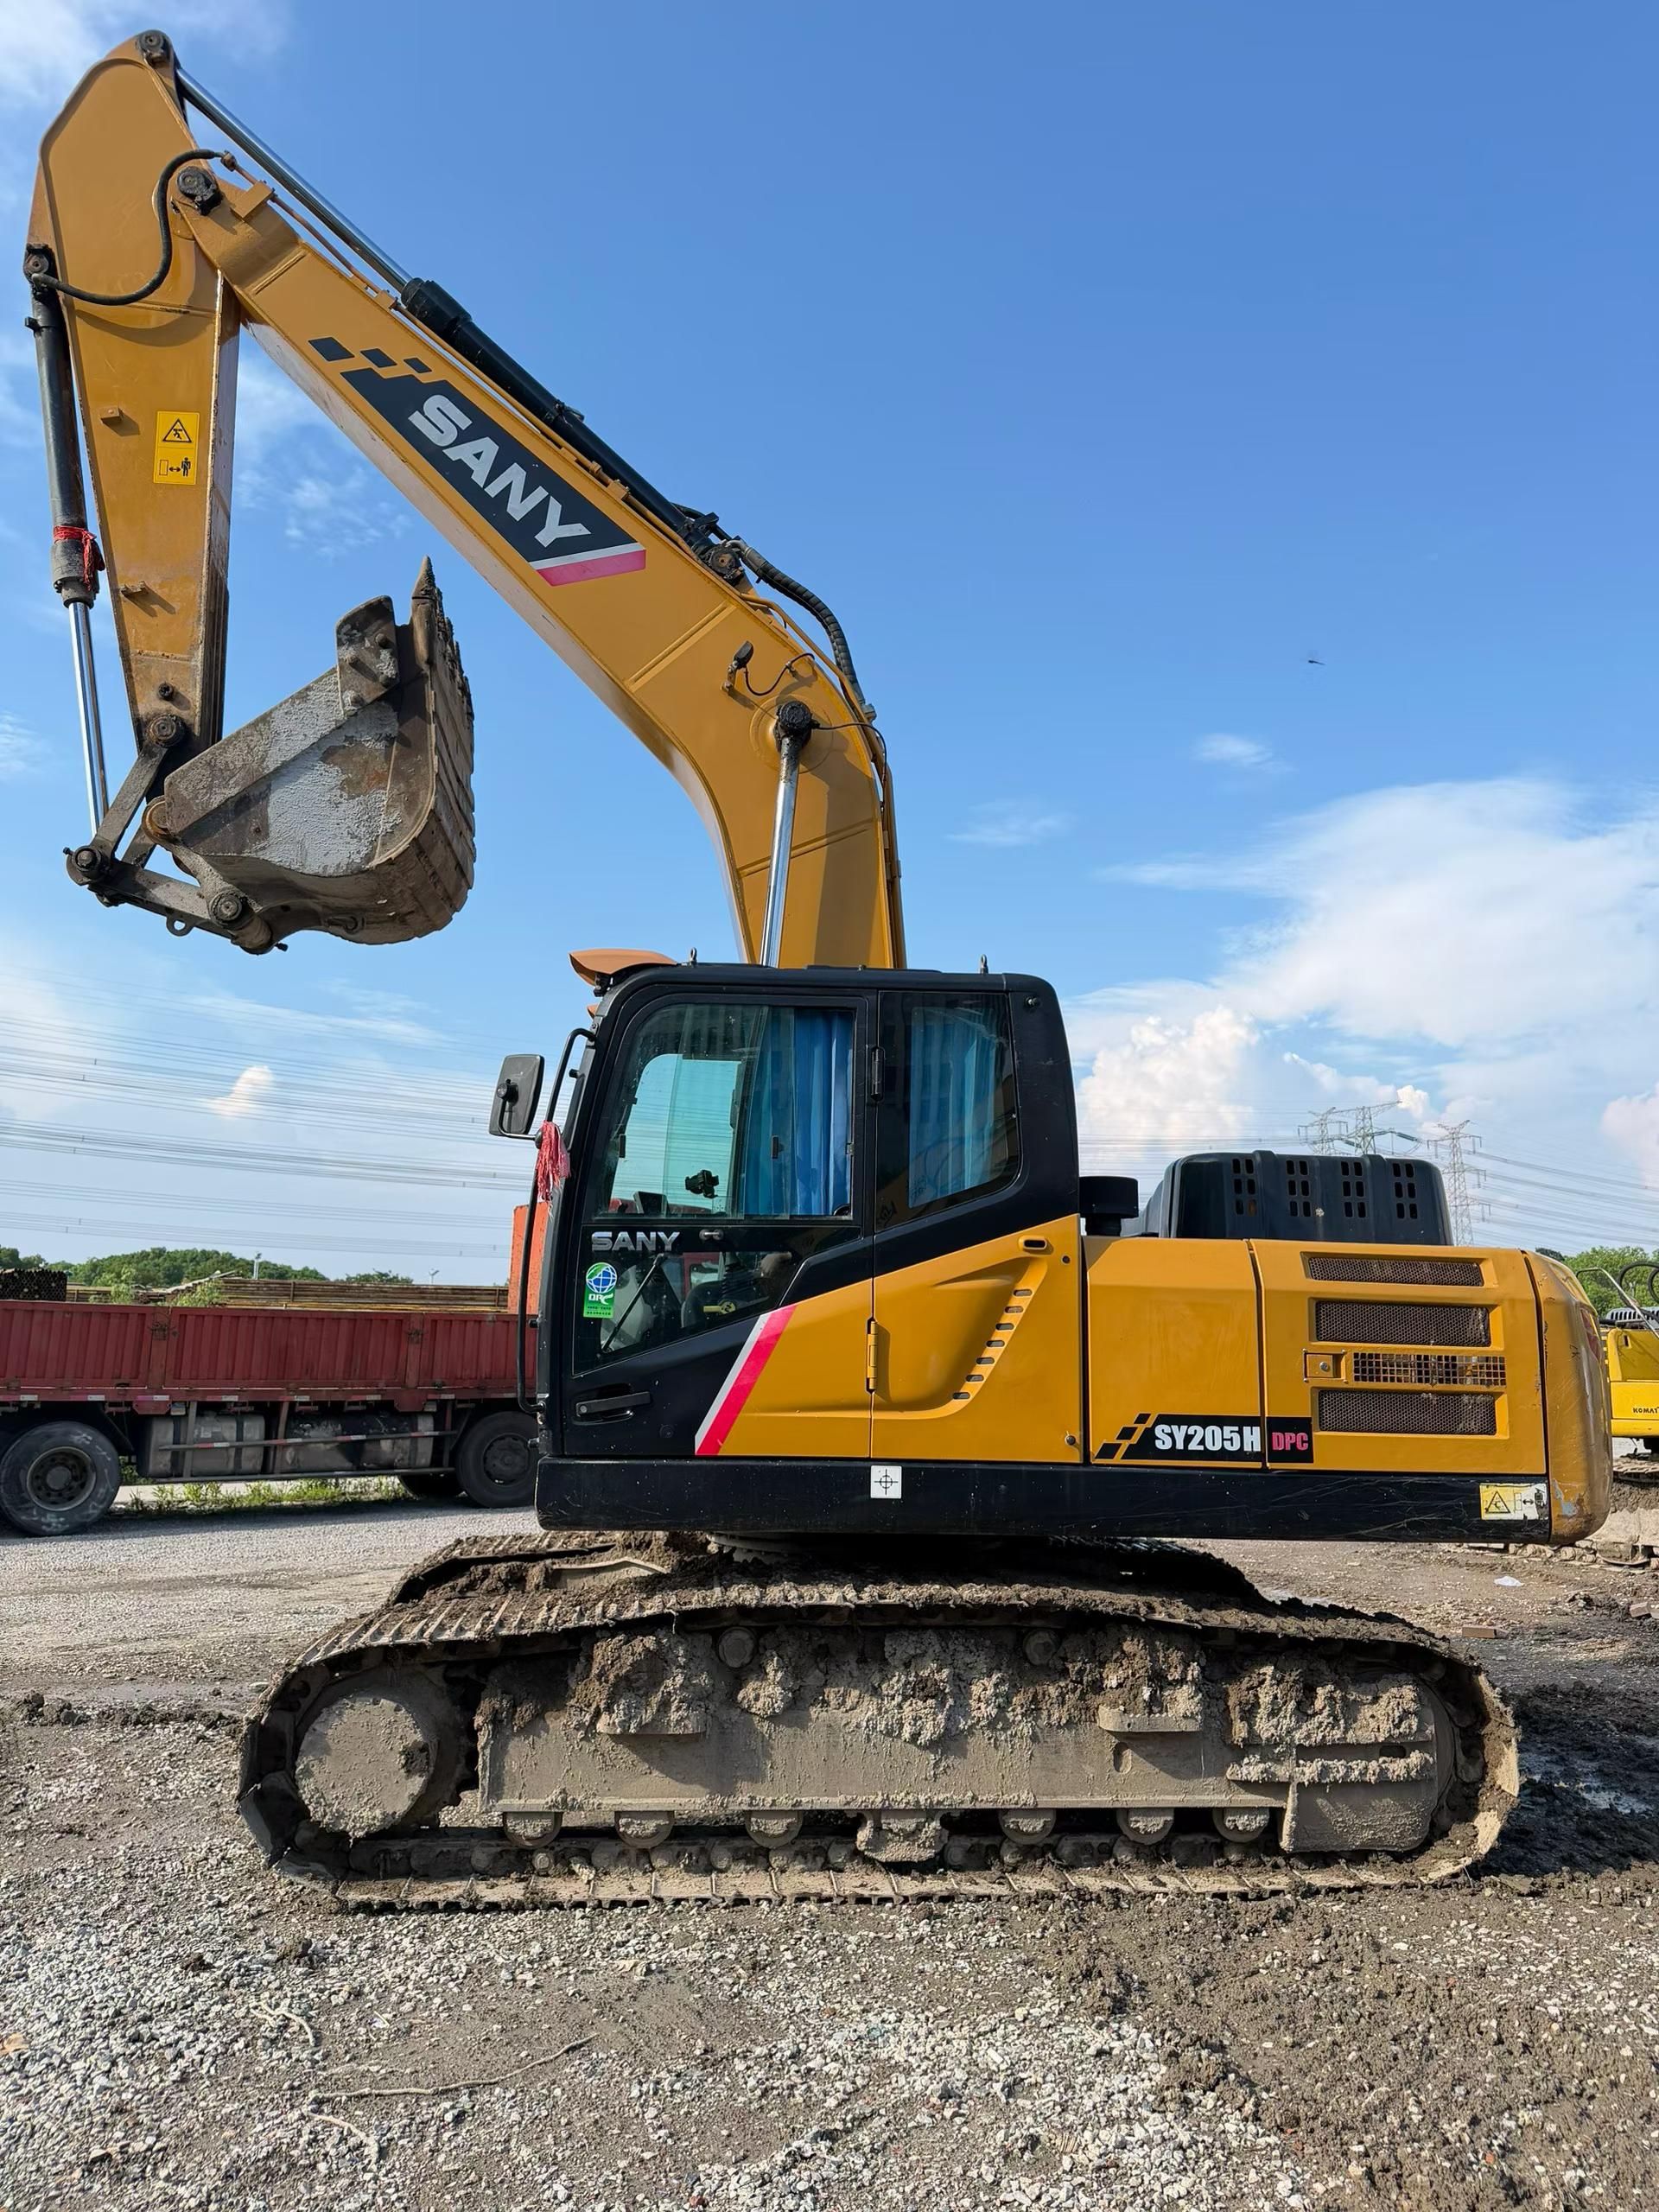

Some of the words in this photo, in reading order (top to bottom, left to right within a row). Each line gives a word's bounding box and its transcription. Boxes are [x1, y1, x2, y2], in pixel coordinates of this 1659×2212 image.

[409, 395, 592, 548] SANY
[591, 1231, 680, 1251] SANY
[1154, 1424, 1262, 1452] SY205H
[1272, 1432, 1309, 1451] DPC
